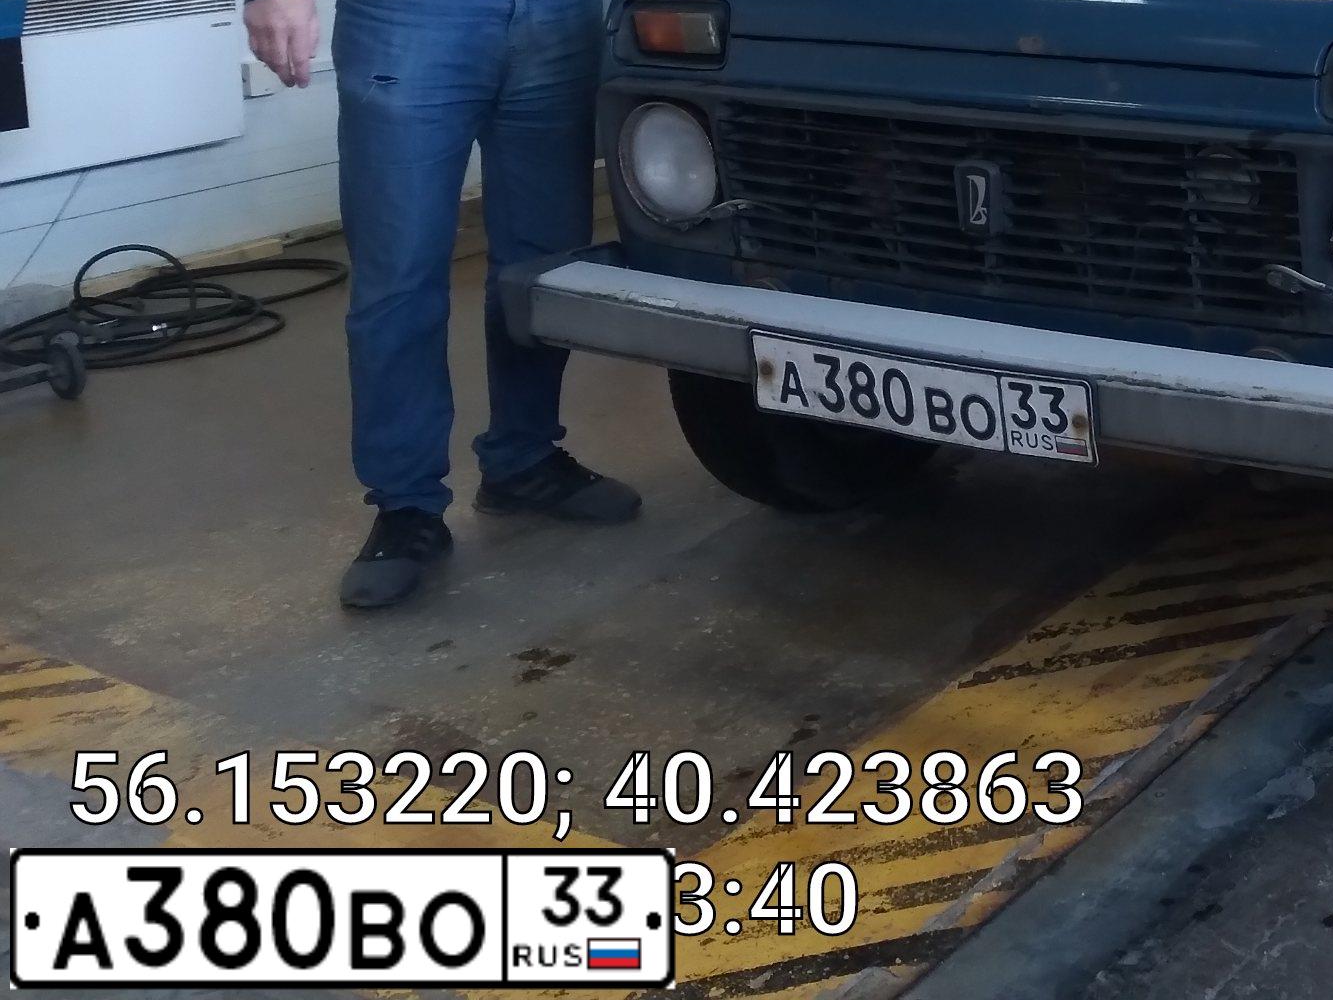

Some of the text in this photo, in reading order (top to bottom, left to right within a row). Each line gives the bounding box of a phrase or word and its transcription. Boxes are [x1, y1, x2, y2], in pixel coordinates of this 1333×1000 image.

[780, 354, 1069, 441] А380ВО 33
[1010, 430, 1055, 451] RUS
